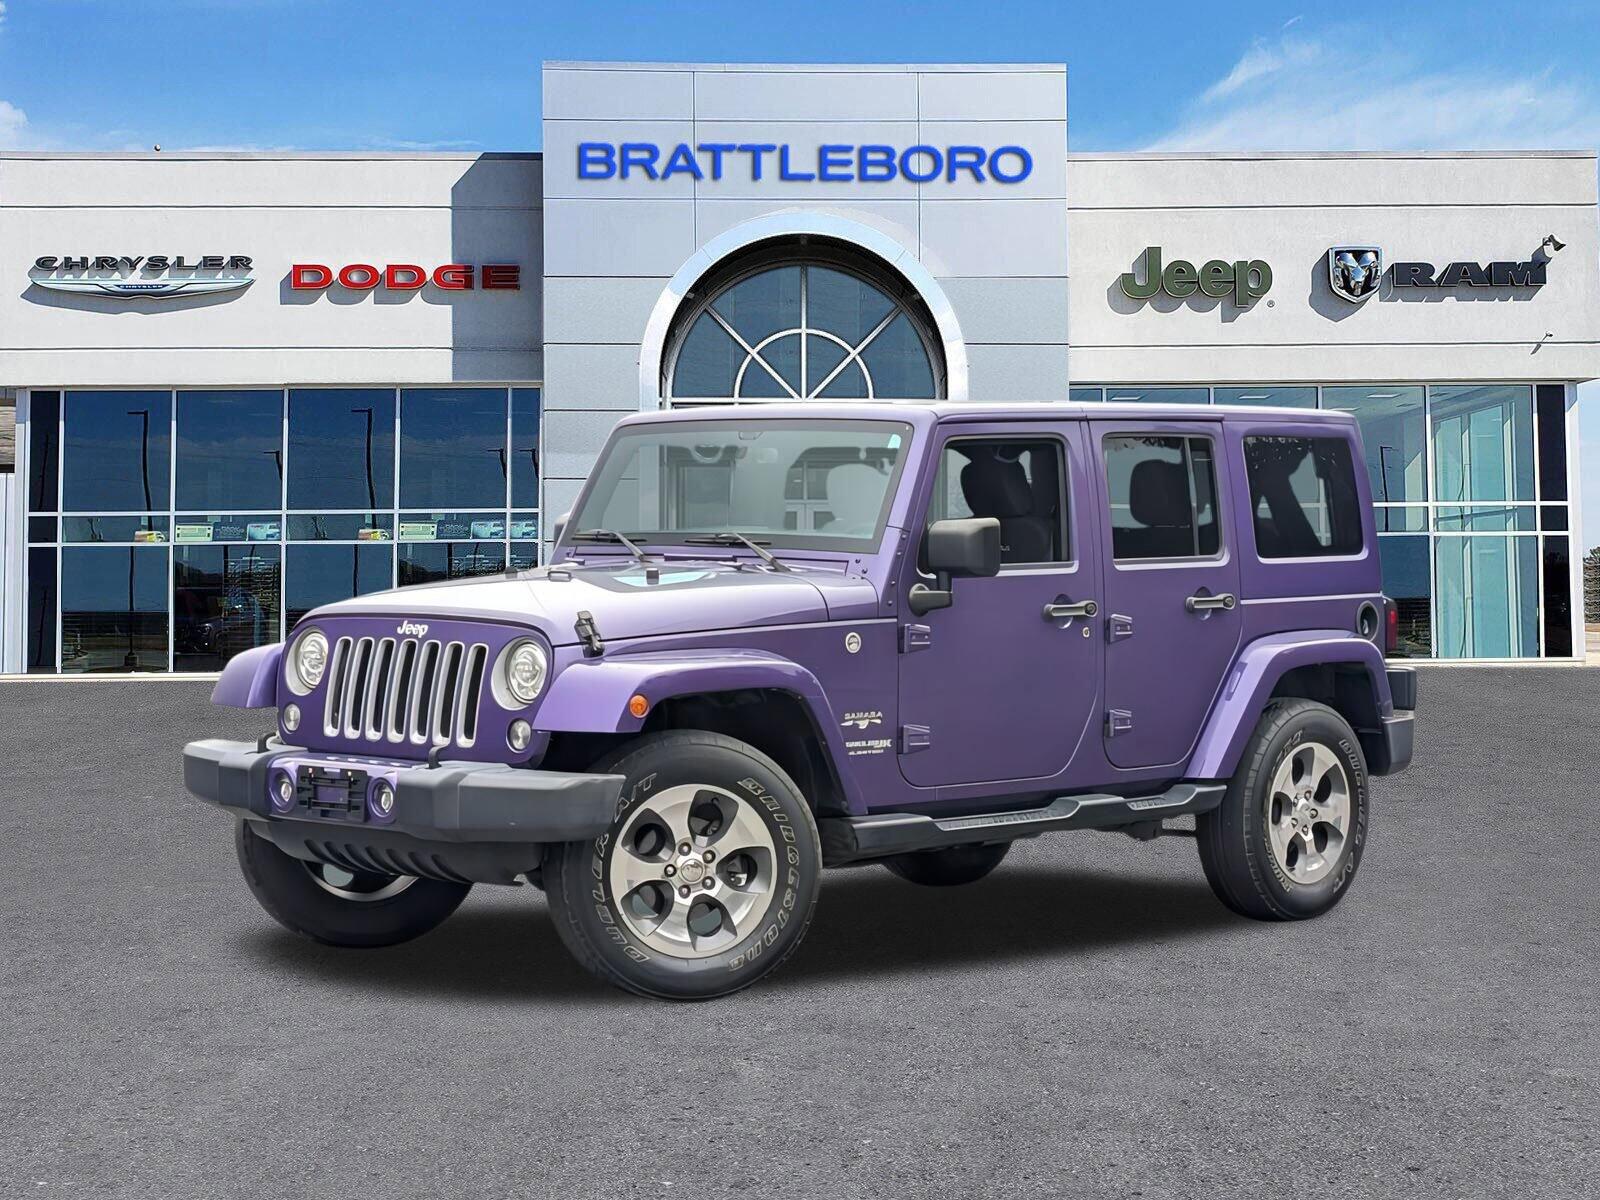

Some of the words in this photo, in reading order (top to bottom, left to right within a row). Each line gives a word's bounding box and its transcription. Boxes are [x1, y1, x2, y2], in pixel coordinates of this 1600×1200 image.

[577, 142, 1035, 184] BRATTLEBORO
[34, 255, 254, 271] CHRYSLER
[1393, 262, 1547, 287] RAM
[291, 264, 521, 290] DODGE
[1120, 246, 1273, 308] Jeep
[397, 620, 429, 638] Jeep
